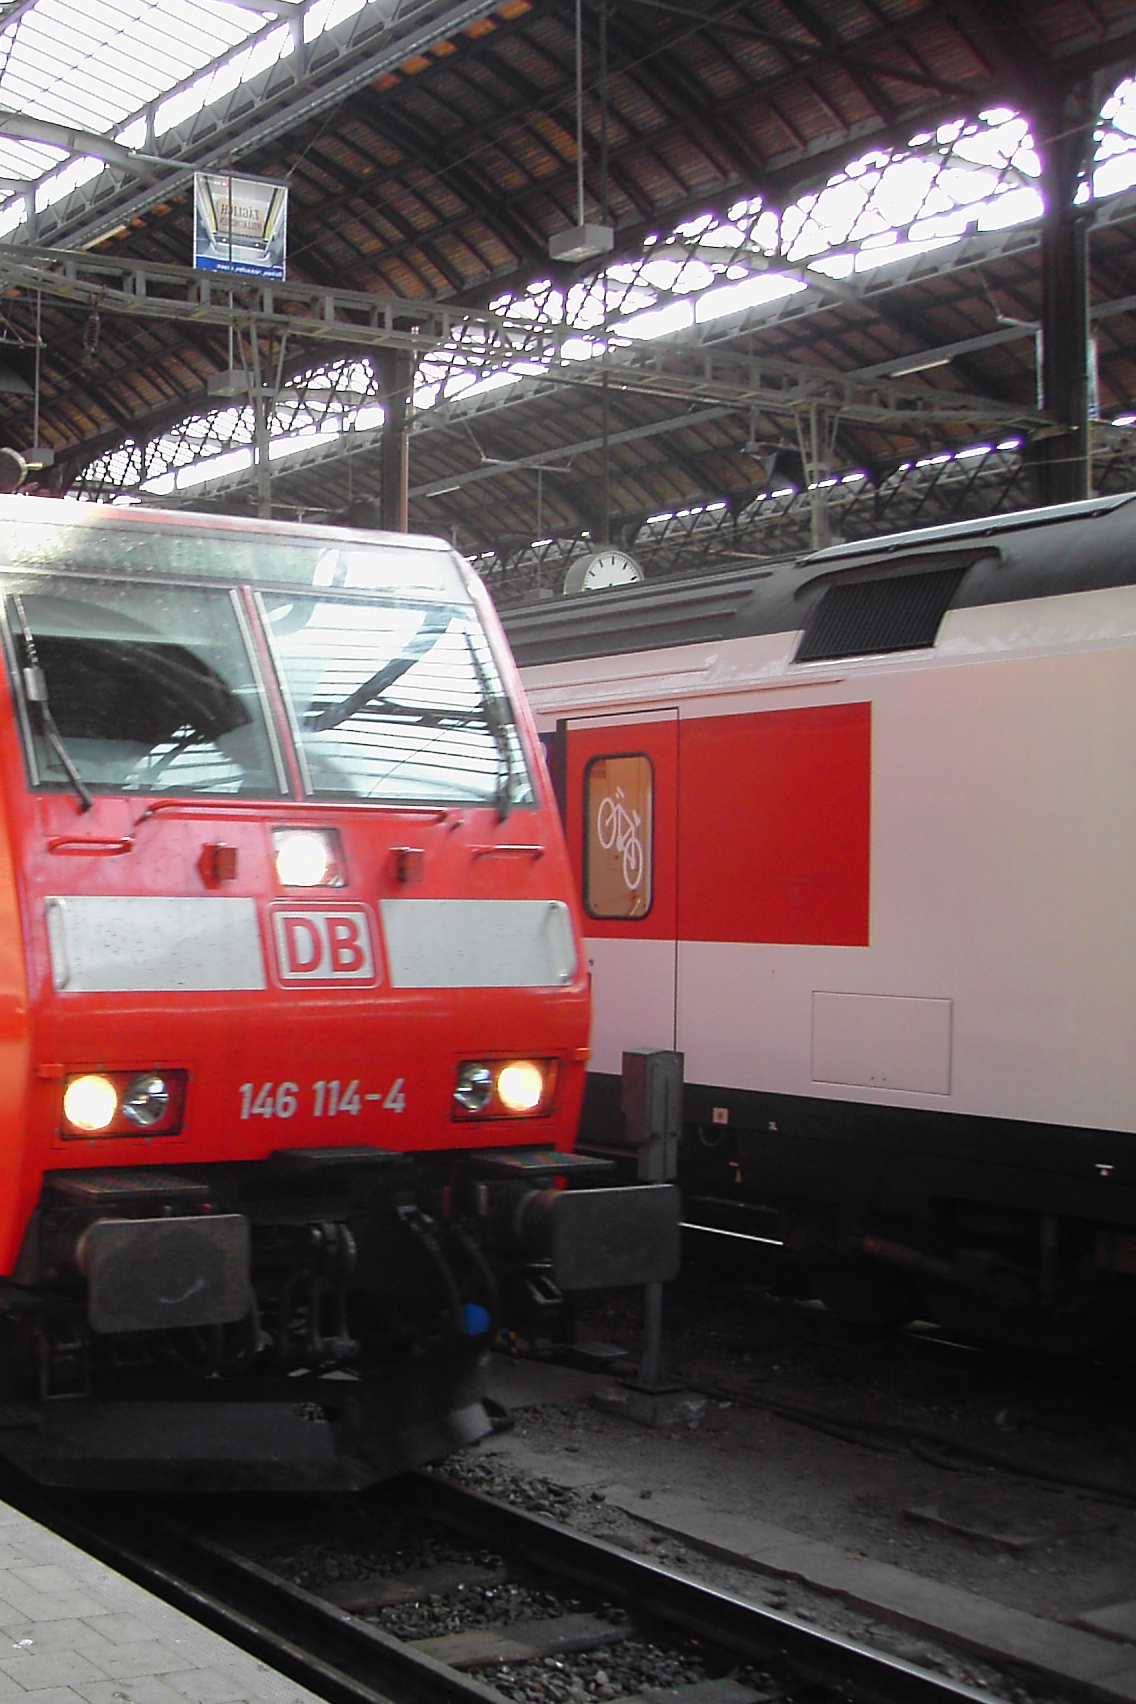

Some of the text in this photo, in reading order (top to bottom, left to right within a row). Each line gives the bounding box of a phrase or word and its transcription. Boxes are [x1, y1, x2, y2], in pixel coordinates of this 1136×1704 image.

[282, 917, 365, 973] DB
[238, 1077, 406, 1120] 146 114-4
